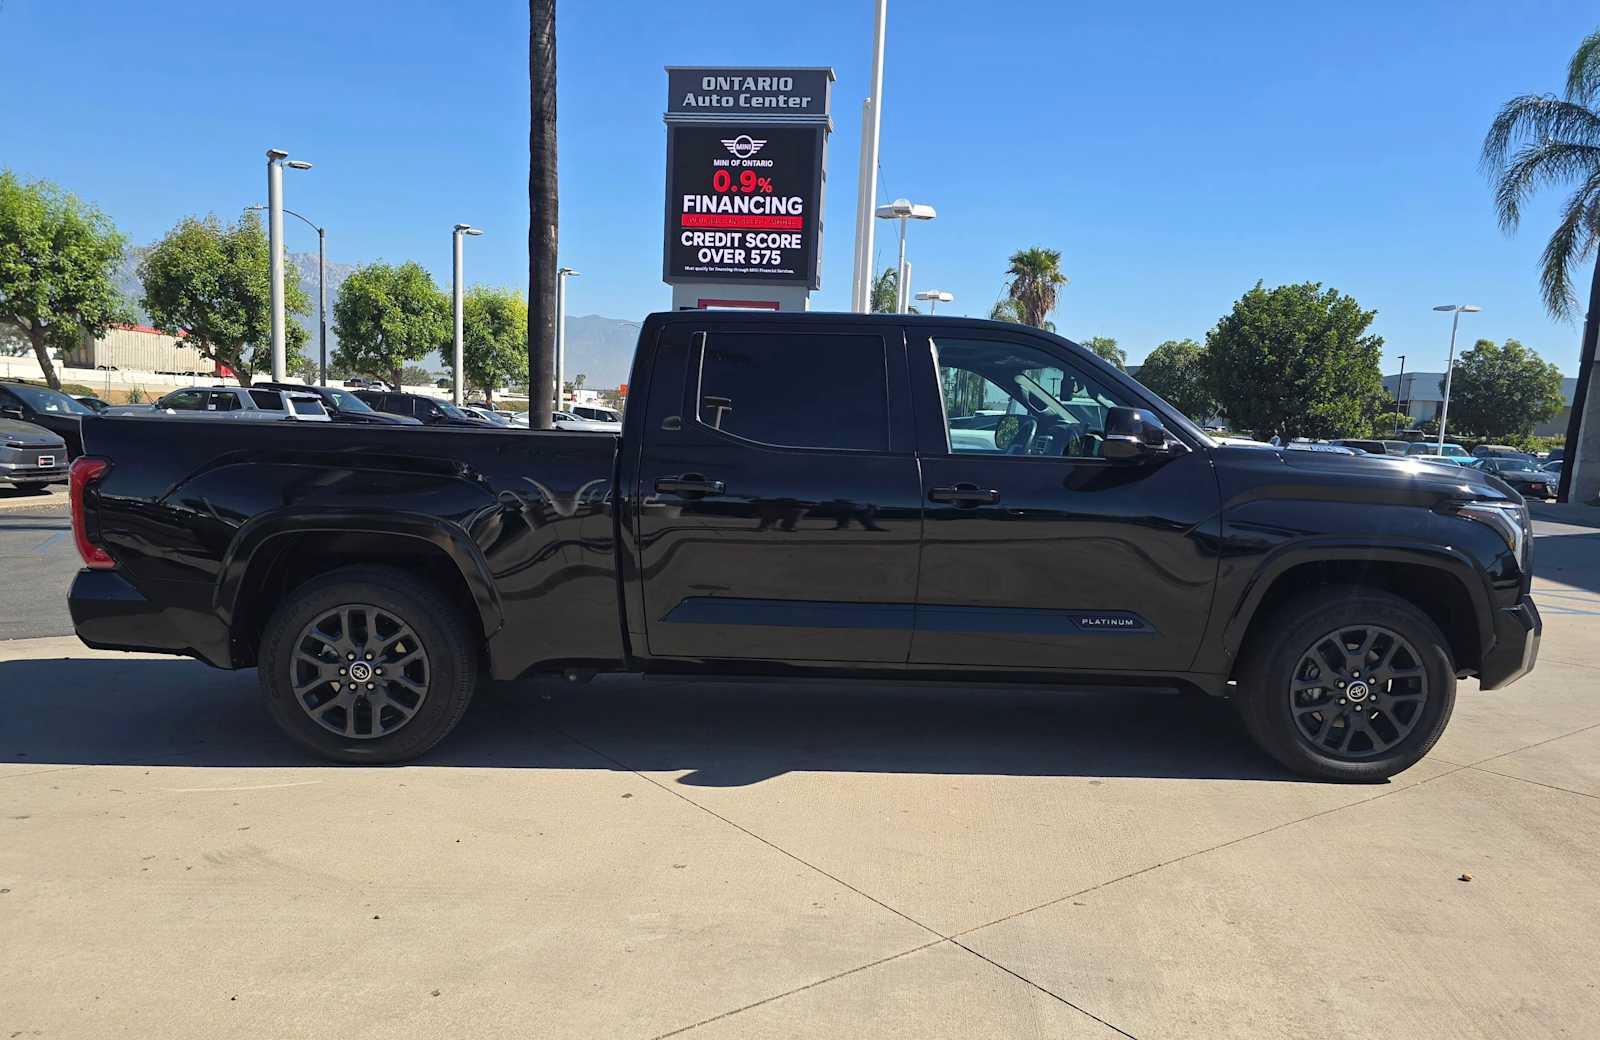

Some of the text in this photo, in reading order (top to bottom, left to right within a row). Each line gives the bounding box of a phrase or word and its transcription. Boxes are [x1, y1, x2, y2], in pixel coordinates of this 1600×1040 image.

[702, 76, 793, 91] ONTARIO
[682, 93, 812, 108] Auto Center
[713, 169, 773, 193] 0.9%
[682, 194, 803, 216] FINANCING
[681, 232, 802, 249] CREDIT SCORE
[698, 248, 781, 265] OVER 575
